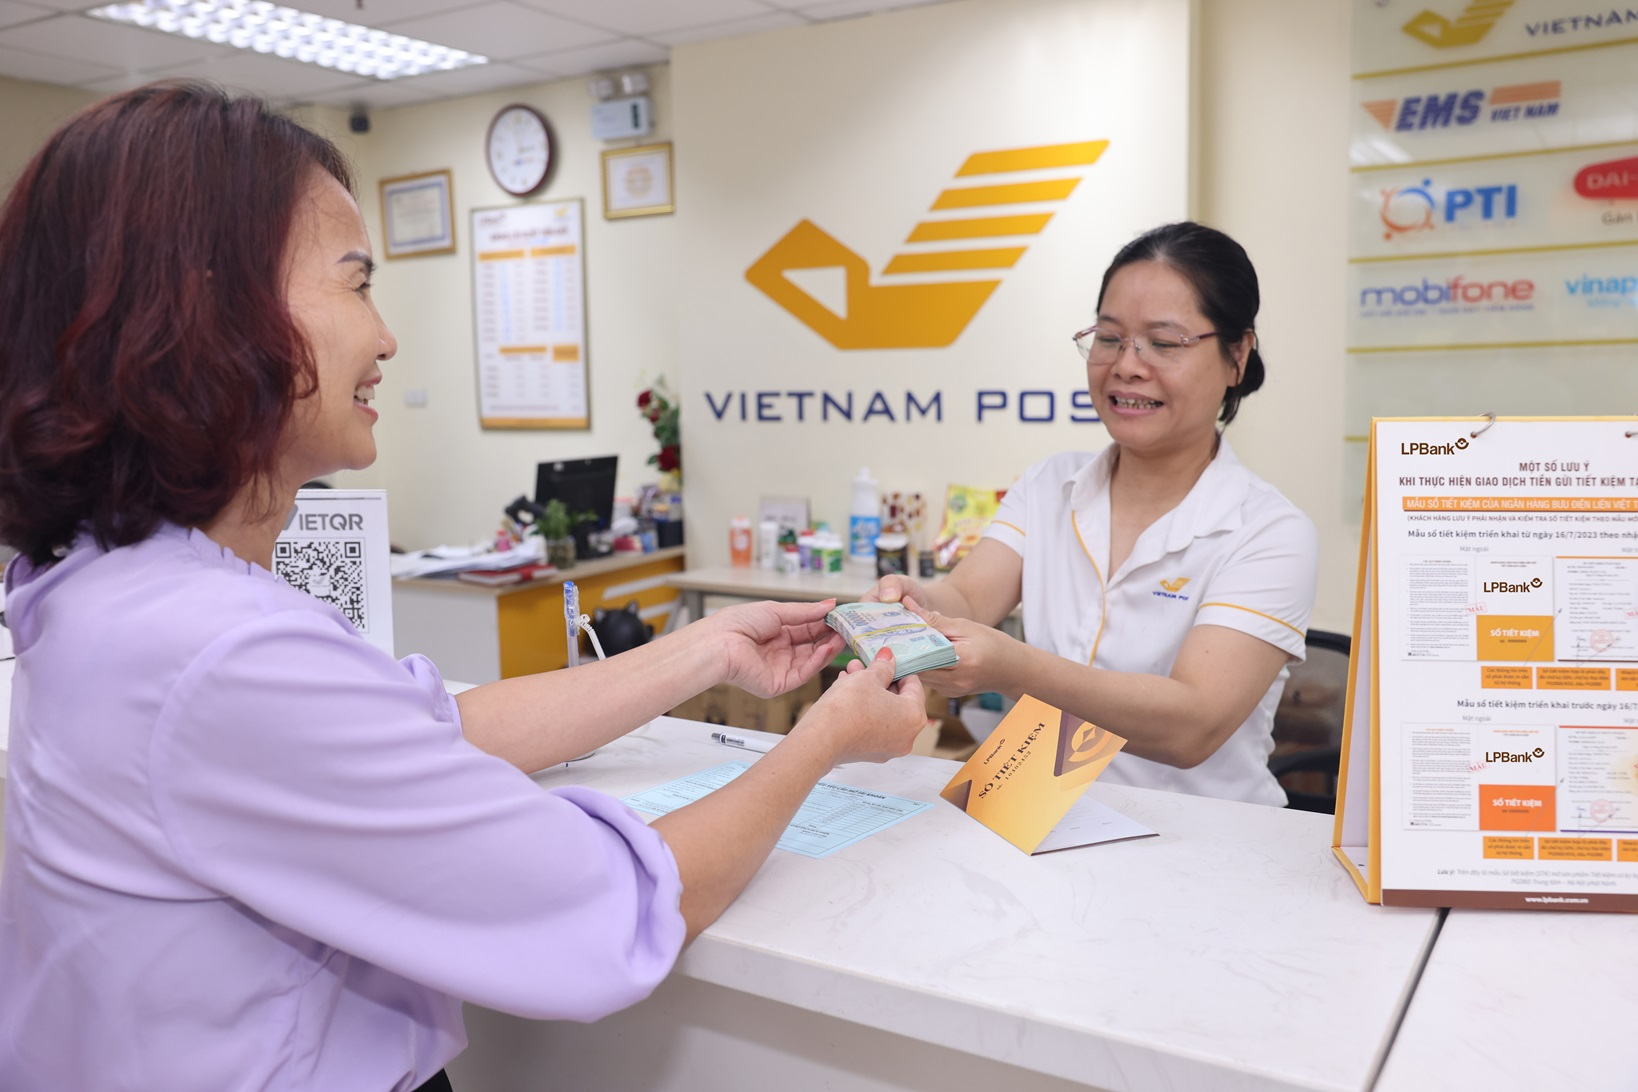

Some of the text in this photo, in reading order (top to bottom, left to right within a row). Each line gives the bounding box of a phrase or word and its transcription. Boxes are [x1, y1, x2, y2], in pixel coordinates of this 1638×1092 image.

[1395, 89, 1486, 132] EMS
[1444, 184, 1517, 223] PTI
[1360, 274, 1535, 307] mobifone
[704, 390, 943, 423] VIETNAM
[1401, 442, 1456, 455] LPBank
[1519, 459, 1590, 474] MỘT SỐ LƯU Ý
[1399, 476, 1415, 486] KHI
[1419, 475, 1445, 488] THỰC
[1449, 475, 1472, 488] HIỆN
[1475, 476, 1499, 486] GIAO
[1502, 476, 1526, 488] DỊCH
[1530, 474, 1552, 487] TIỀN
[1555, 474, 1572, 487] GỬI
[1576, 474, 1597, 487] TIẾT
[1600, 475, 1625, 488] KIỆM
[1407, 497, 1426, 508] MẪU
[1441, 497, 1458, 508] TIẾT
[1460, 498, 1479, 510] KIỆM
[1482, 497, 1499, 508] CỦA
[1501, 498, 1525, 509] NGÂN
[1526, 498, 1550, 509] HÀNG
[1408, 529, 1425, 538] Mẫu
[1439, 529, 1454, 538] tiết
[1456, 530, 1476, 540] kiệm
[1501, 530, 1519, 538] khai
[1533, 531, 1553, 540] ngày
[1555, 531, 1598, 539] 16/7/2023
[1600, 531, 1619, 539] theo
[1483, 582, 1531, 593] LPBank
[1457, 699, 1474, 708] Mẫu
[1488, 699, 1503, 708] tiết
[1505, 700, 1526, 710] kiệm
[1551, 701, 1569, 709] khai
[1597, 702, 1617, 711] ngày
[992, 753, 1017, 780] TIẾT
[1017, 722, 1045, 754] KIỆM
[1485, 751, 1532, 763] LPBank
